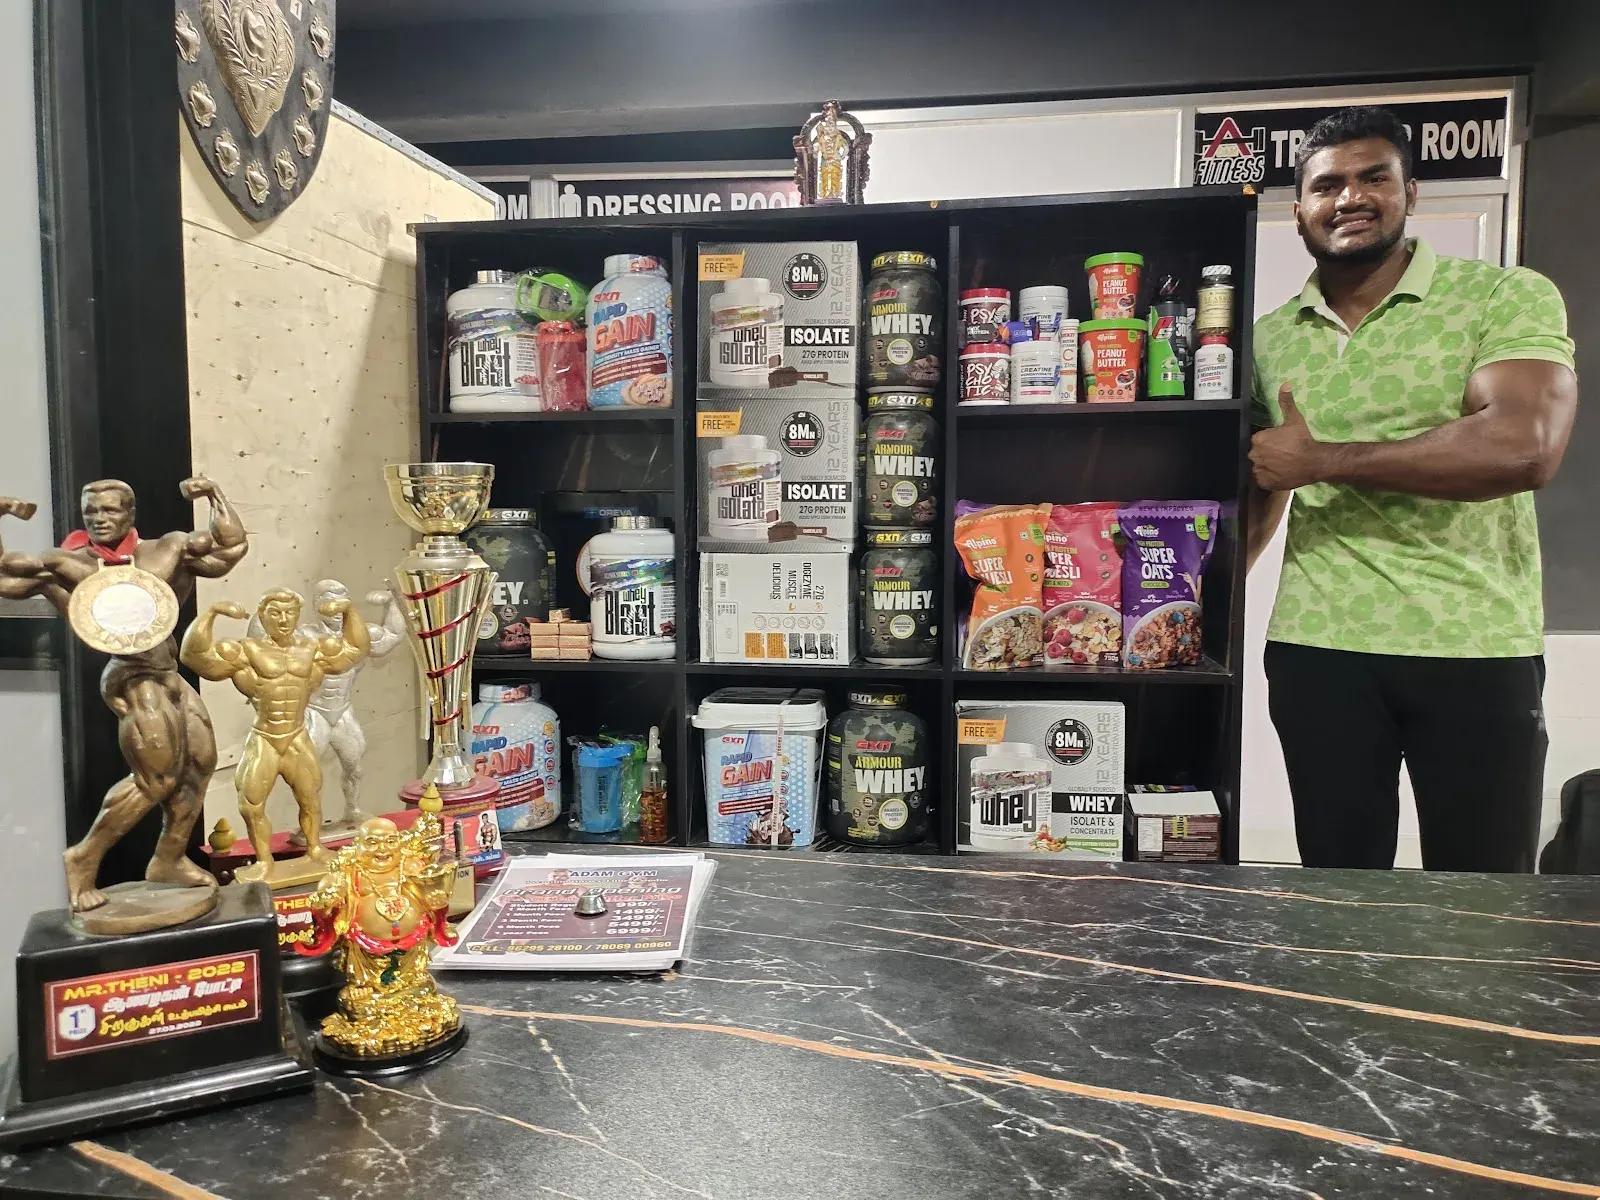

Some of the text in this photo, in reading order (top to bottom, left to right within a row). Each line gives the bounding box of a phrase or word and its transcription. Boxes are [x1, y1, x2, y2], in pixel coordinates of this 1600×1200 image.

[1421, 119, 1505, 160] ROOM
[586, 193, 722, 217] DRESSING
[704, 262, 724, 273] FREE
[1102, 279, 1128, 288] PEANUT
[1102, 287, 1128, 295] BUTTER
[871, 302, 907, 316] ARMOUR
[593, 312, 657, 354] GAIN
[790, 327, 850, 345] ISOLATE
[802, 350, 849, 359] 27G PROTEIN
[1062, 349, 1074, 361] C
[1097, 348, 1127, 358] PEANUT
[1097, 358, 1127, 368] BUTTER
[702, 419, 722, 430] FREE
[874, 444, 913, 456] ARMOUR
[787, 484, 847, 500] ISOLATE
[799, 505, 846, 514] 27G PROTEIN
[964, 537, 998, 550] Alpino
[1044, 532, 1068, 543] pino
[1140, 547, 1177, 564] SUPER
[972, 556, 1005, 573] SUPER
[1141, 562, 1174, 580] OATS
[772, 562, 782, 600] DELICIOUS
[787, 570, 797, 600] MUSCLE
[873, 580, 911, 591] ARMOUR
[964, 726, 985, 737] FREE
[473, 743, 533, 777] GAIN
[855, 756, 902, 769] ARMOUR
[721, 760, 773, 787] GAIN
[1068, 795, 1116, 813] WHEY
[1070, 816, 1106, 827] ISOLATE
[608, 920, 663, 928] 5499/-
[606, 927, 662, 935] 6999/-
[507, 944, 544, 952] 96295
[635, 941, 672, 949] 00960
[63, 960, 246, 1001] MR.THENI 2022
